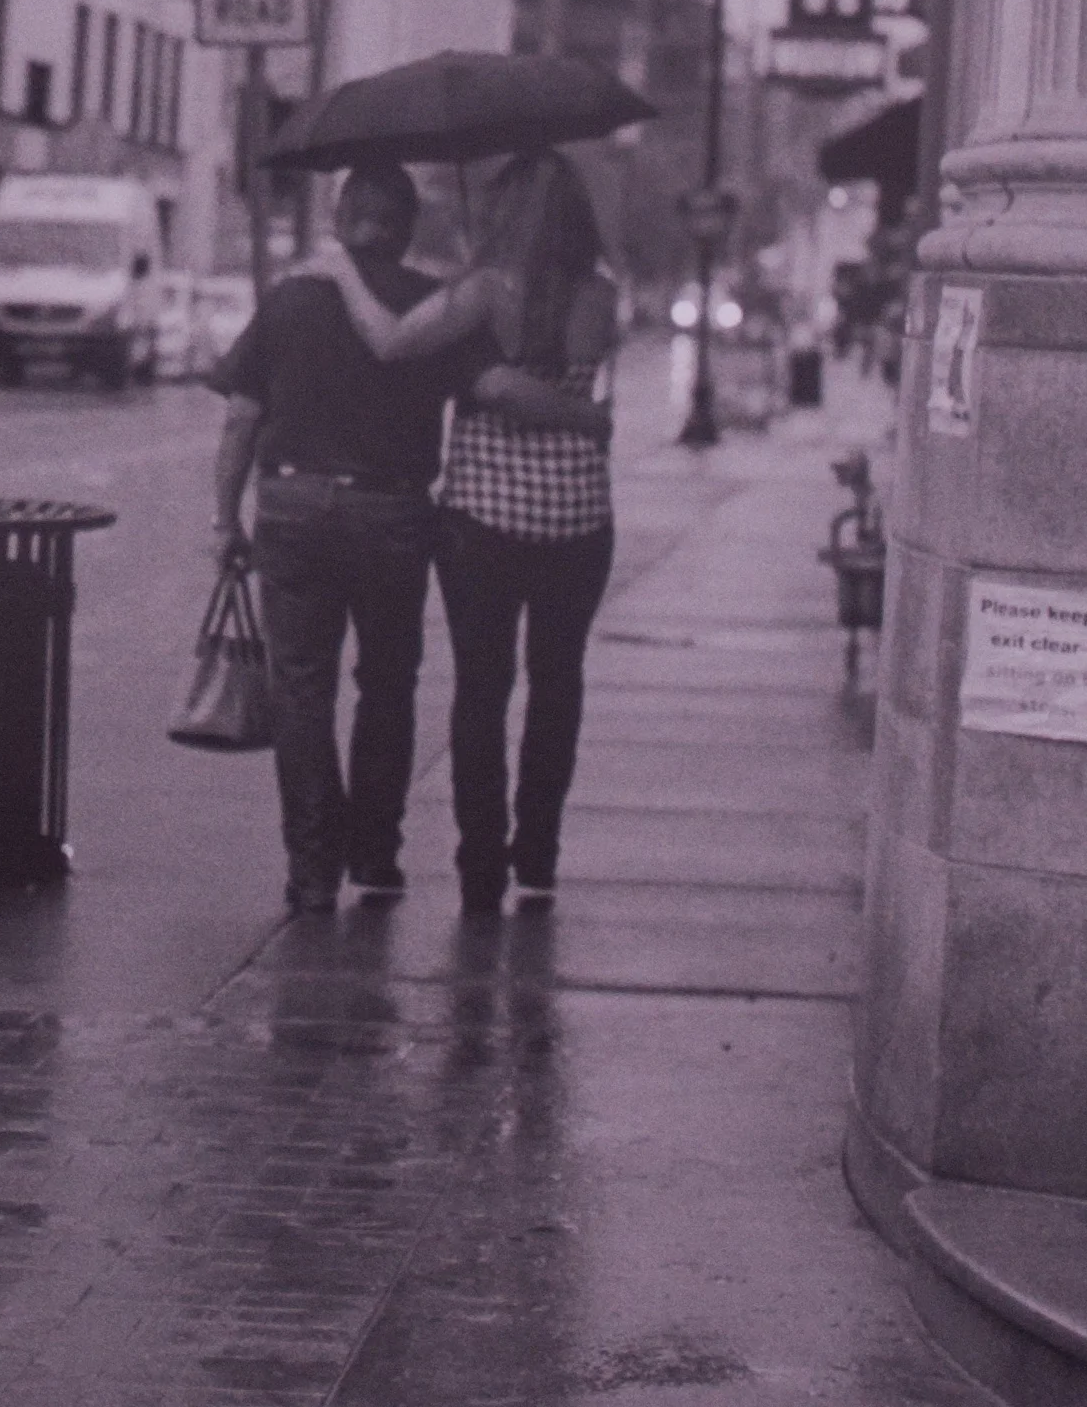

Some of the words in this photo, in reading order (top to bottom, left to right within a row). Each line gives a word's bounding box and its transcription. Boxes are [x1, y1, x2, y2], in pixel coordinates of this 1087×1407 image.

[980, 598, 1041, 619] Please
[990, 635, 1025, 649] exit
[1030, 637, 1080, 654] clear
